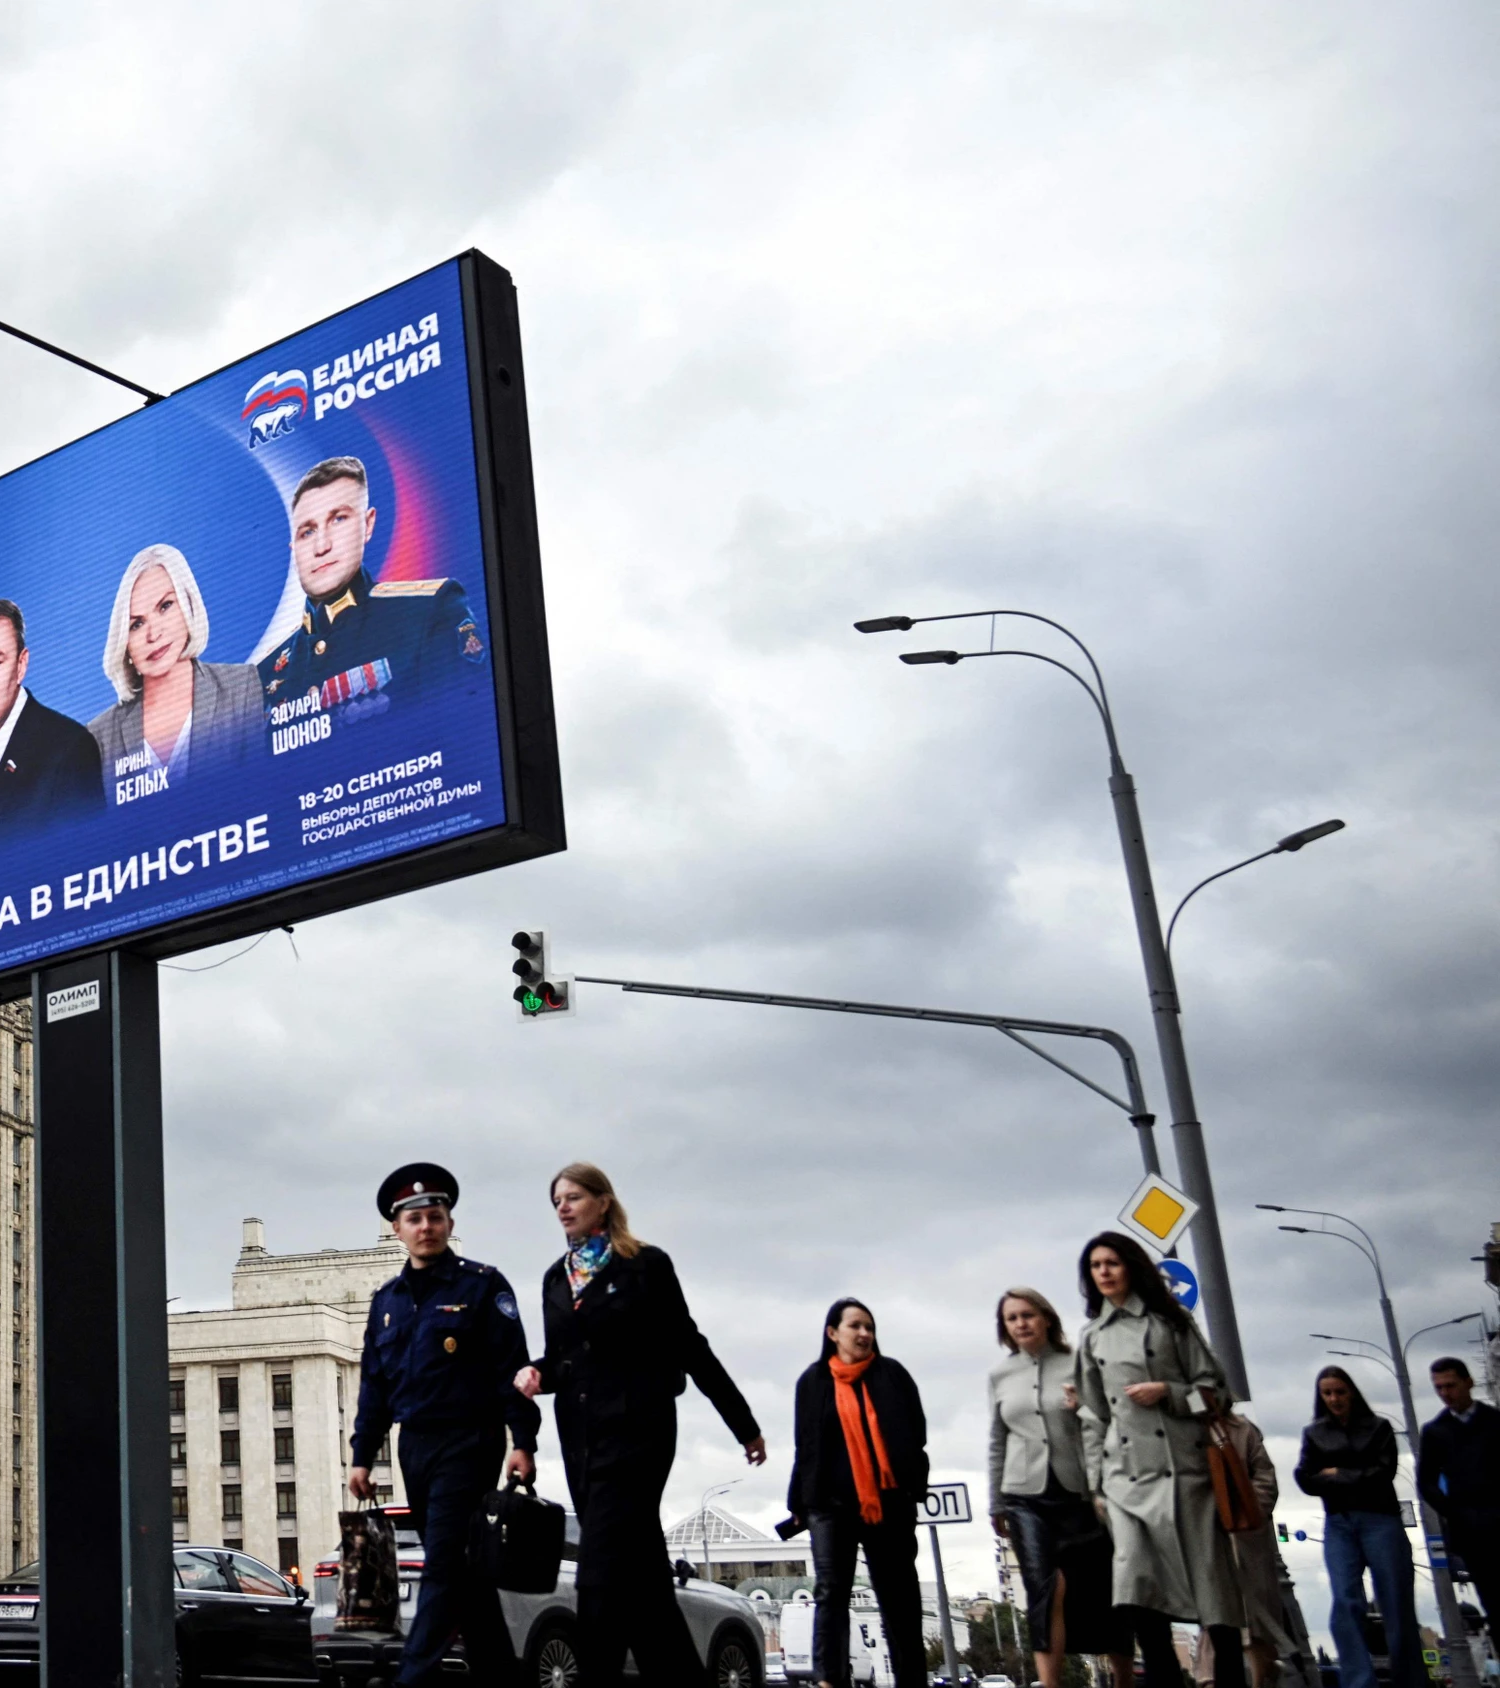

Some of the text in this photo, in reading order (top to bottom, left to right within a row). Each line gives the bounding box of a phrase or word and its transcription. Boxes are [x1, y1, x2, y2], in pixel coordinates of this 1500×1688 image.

[311, 312, 439, 391] ЕДИНАЯ
[314, 341, 442, 421] РОССИЯ
[271, 691, 322, 725] ЭДУАРД
[272, 714, 332, 755] ШОНОВ
[115, 750, 151, 777] ИРИНА
[347, 751, 442, 795] СЕНТЯБРЯ
[116, 766, 169, 805] БЕЛЫХ
[301, 776, 443, 832] ВЫБОРЫ ДЕПУТАТОВ
[302, 794, 435, 846] ГОСУДАРСТВЕННОЙ
[437, 780, 482, 807] ДУМЫ
[30, 884, 53, 921] В
[63, 813, 270, 911] ЕДИНСТВЕ
[49, 984, 97, 1006] ОЛИМП
[925, 1491, 959, 1517] ОП
